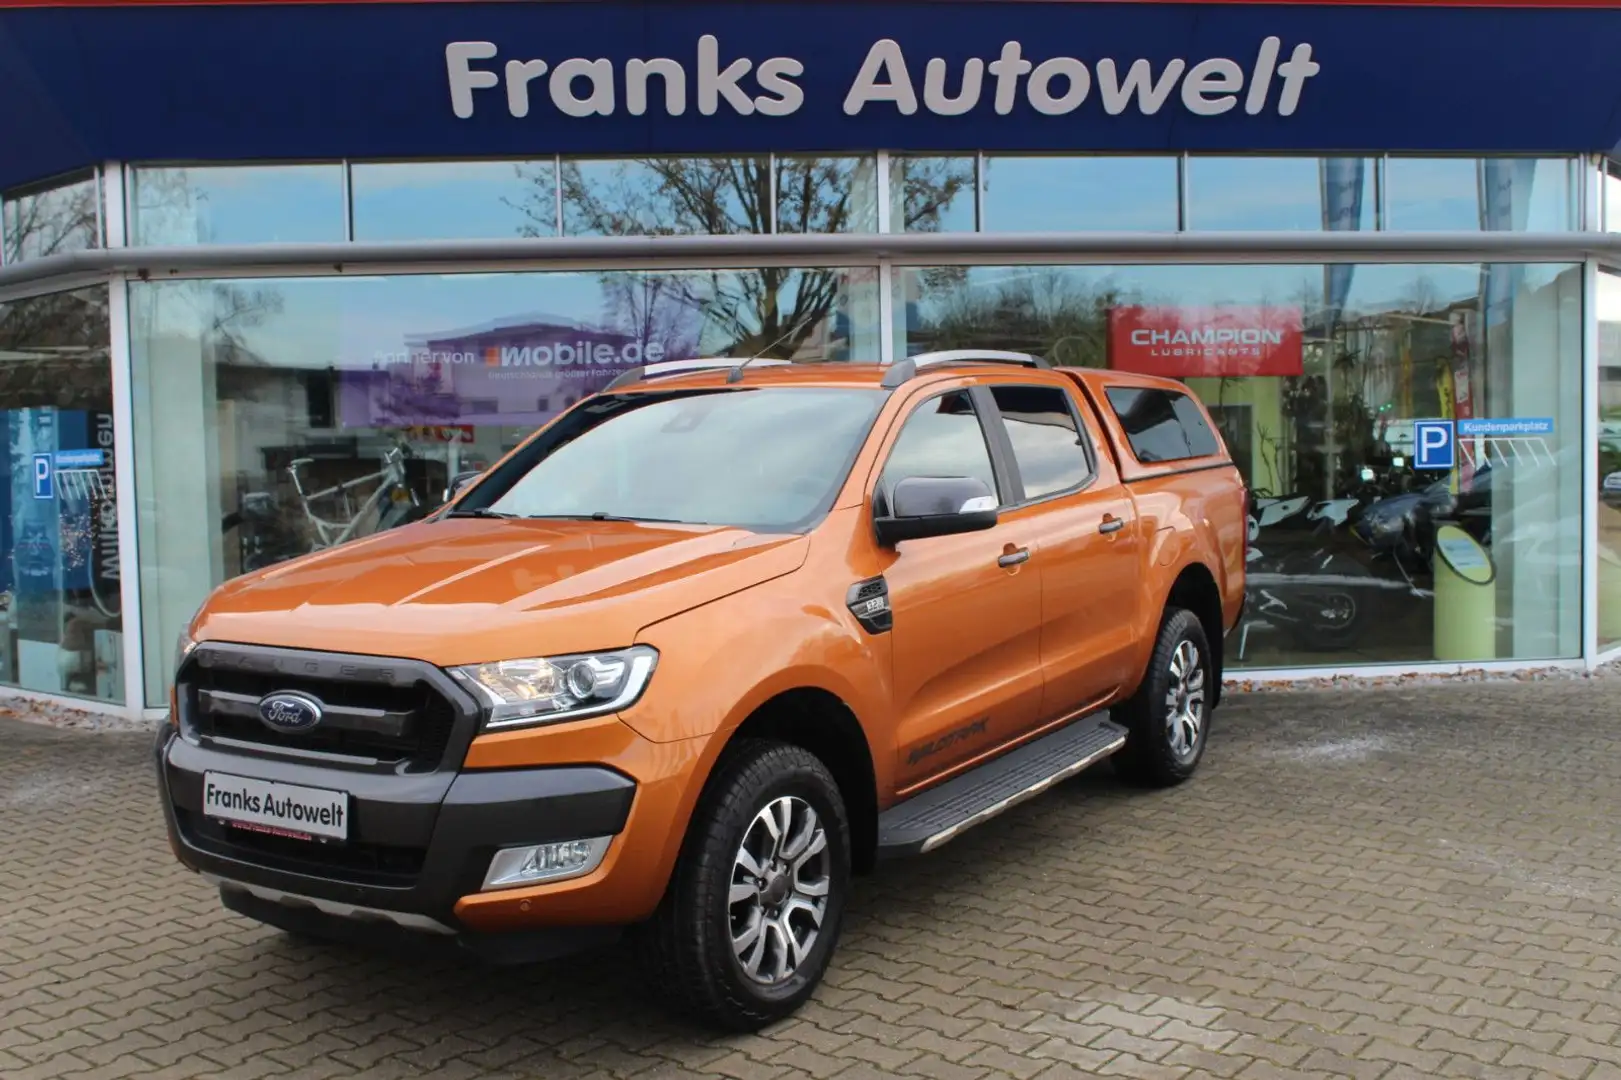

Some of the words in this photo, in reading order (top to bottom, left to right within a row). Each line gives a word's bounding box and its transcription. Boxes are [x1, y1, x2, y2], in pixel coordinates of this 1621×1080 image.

[446, 34, 804, 118] Franks
[843, 36, 1320, 116] Autowelt
[1131, 329, 1281, 345] CHAMPION
[443, 351, 475, 364] von
[501, 337, 665, 367] mobile.de
[1151, 348, 1261, 357] LUBRICANTS
[1463, 422, 1549, 433] Kundenparkplatz
[1421, 426, 1448, 463] P
[35, 458, 49, 494] P
[268, 700, 303, 723] Ford
[206, 783, 260, 813] Franks
[263, 793, 344, 828] Autowelt
